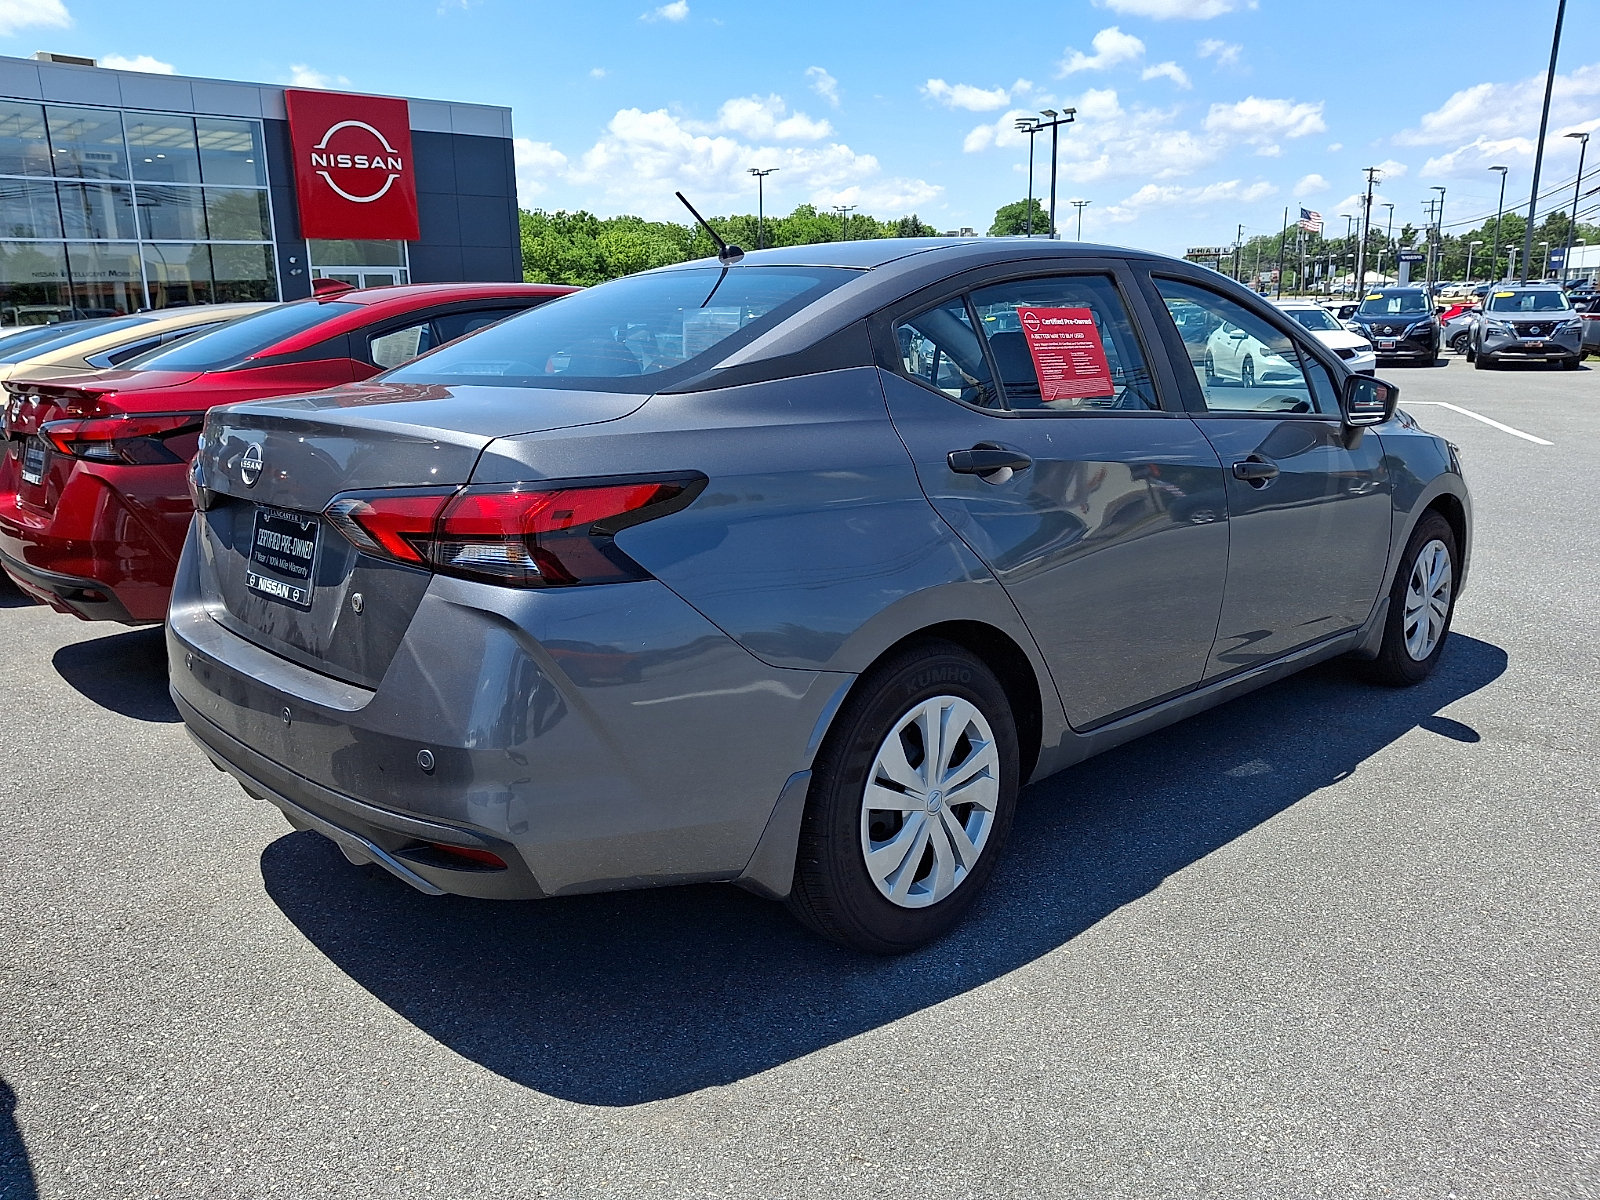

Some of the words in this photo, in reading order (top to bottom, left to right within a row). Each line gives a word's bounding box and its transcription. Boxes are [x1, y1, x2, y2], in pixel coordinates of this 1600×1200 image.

[311, 152, 403, 171] NISSAN
[270, 510, 299, 522] LANCASTER
[257, 528, 281, 551] CERTIFIED
[280, 534, 314, 560] PRE-OWNED
[288, 561, 309, 578] Warranty
[258, 577, 290, 599] NISSAN
[906, 668, 972, 693] KUMHO
